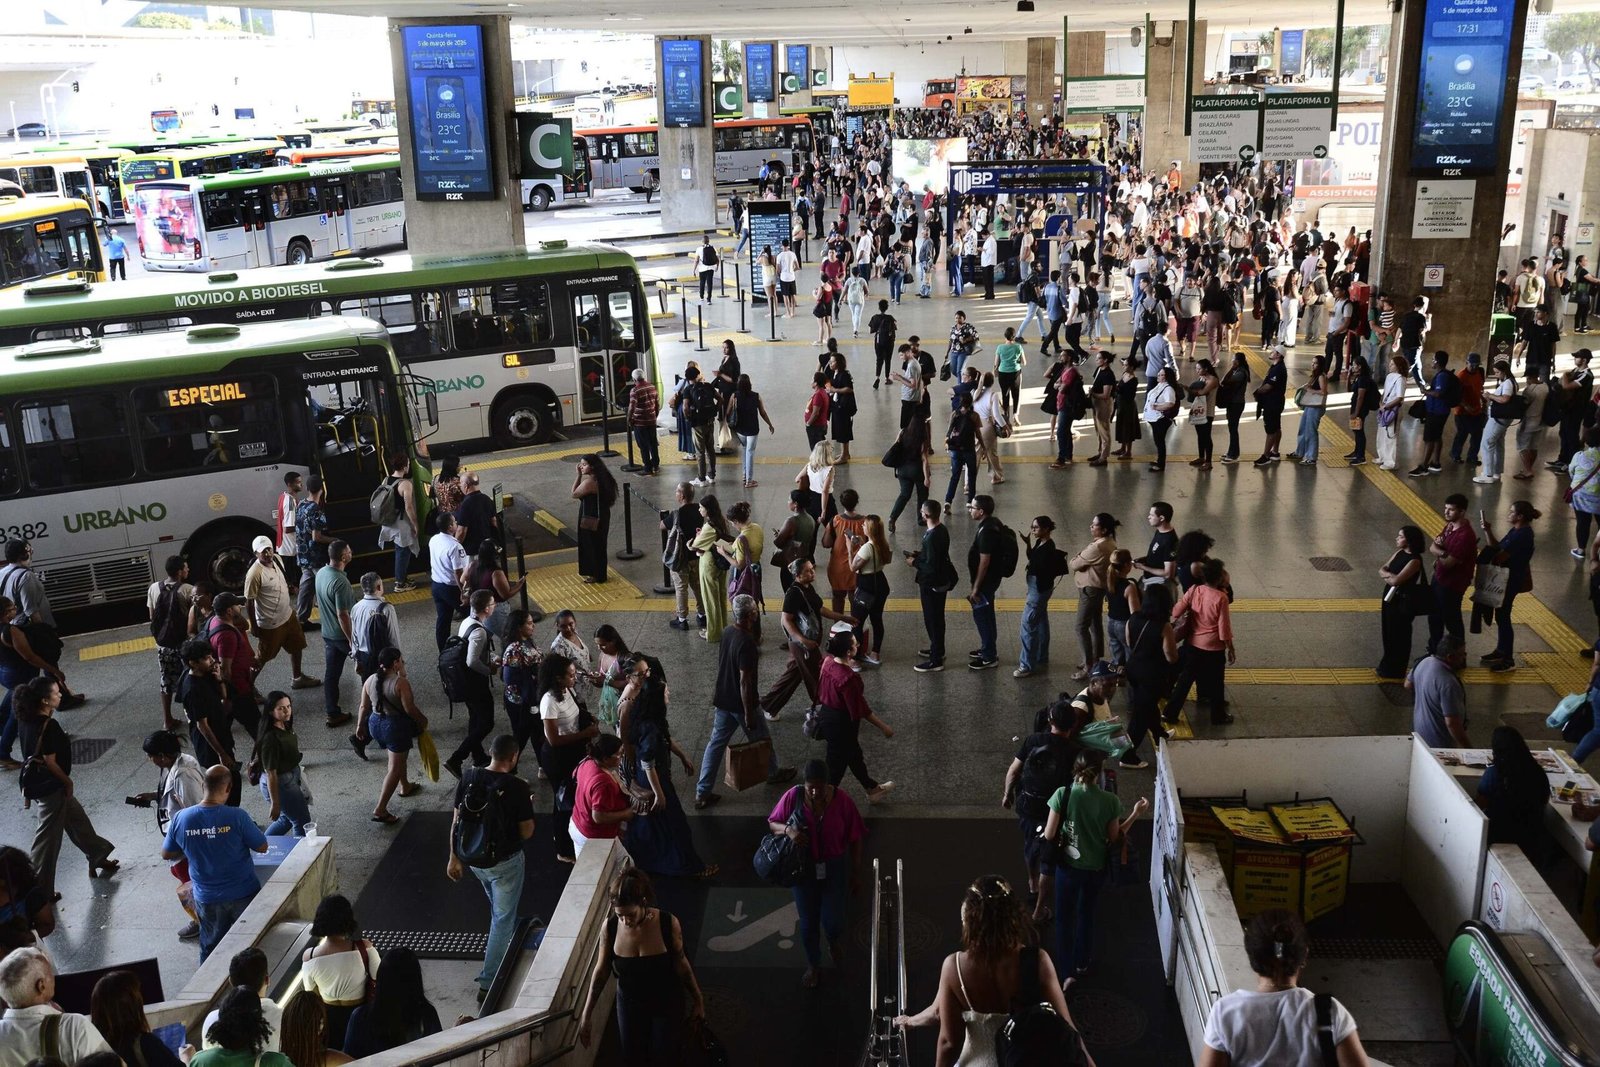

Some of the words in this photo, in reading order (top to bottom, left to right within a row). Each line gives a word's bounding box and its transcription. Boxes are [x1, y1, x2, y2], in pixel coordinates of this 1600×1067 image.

[1457, 24, 1479, 34] 17:31
[1261, 56, 1272, 68] D
[784, 75, 796, 92] C
[815, 72, 825, 84] C
[1448, 82, 1476, 91] Brasília
[719, 87, 737, 111] C
[1195, 98, 1249, 108] PLATAFORMA
[1250, 98, 1258, 106] C
[1267, 96, 1322, 105] PLATAFORMA
[1323, 96, 1331, 104] D
[1447, 96, 1474, 107] 23°C
[438, 125, 461, 135] 23°C
[1337, 122, 1380, 146] POI
[529, 123, 563, 169] C
[1436, 156, 1456, 164] RZK
[1443, 168, 1462, 176] RZK
[972, 171, 994, 185] BP
[438, 181, 456, 189] RZK
[446, 193, 464, 201] RZK
[566, 278, 590, 286] ENTRADA
[591, 275, 619, 283] ENTRANCE
[174, 291, 234, 308] MOVIDO
[238, 289, 249, 302] A
[251, 282, 328, 301] BIODIESEL
[235, 310, 257, 319] SAÍDA
[260, 308, 276, 316] EXIT
[505, 354, 521, 367] SUL
[302, 370, 336, 380] ENTRADA
[341, 366, 379, 376] ENTRANCE
[168, 382, 247, 407] ESPECIAL
[63, 502, 167, 534] URBANO
[201, 826, 216, 835] PRÉ
[217, 826, 231, 834] XIP
[1469, 941, 1502, 1004] ESCADA
[1503, 994, 1547, 1067] ROLANTE
